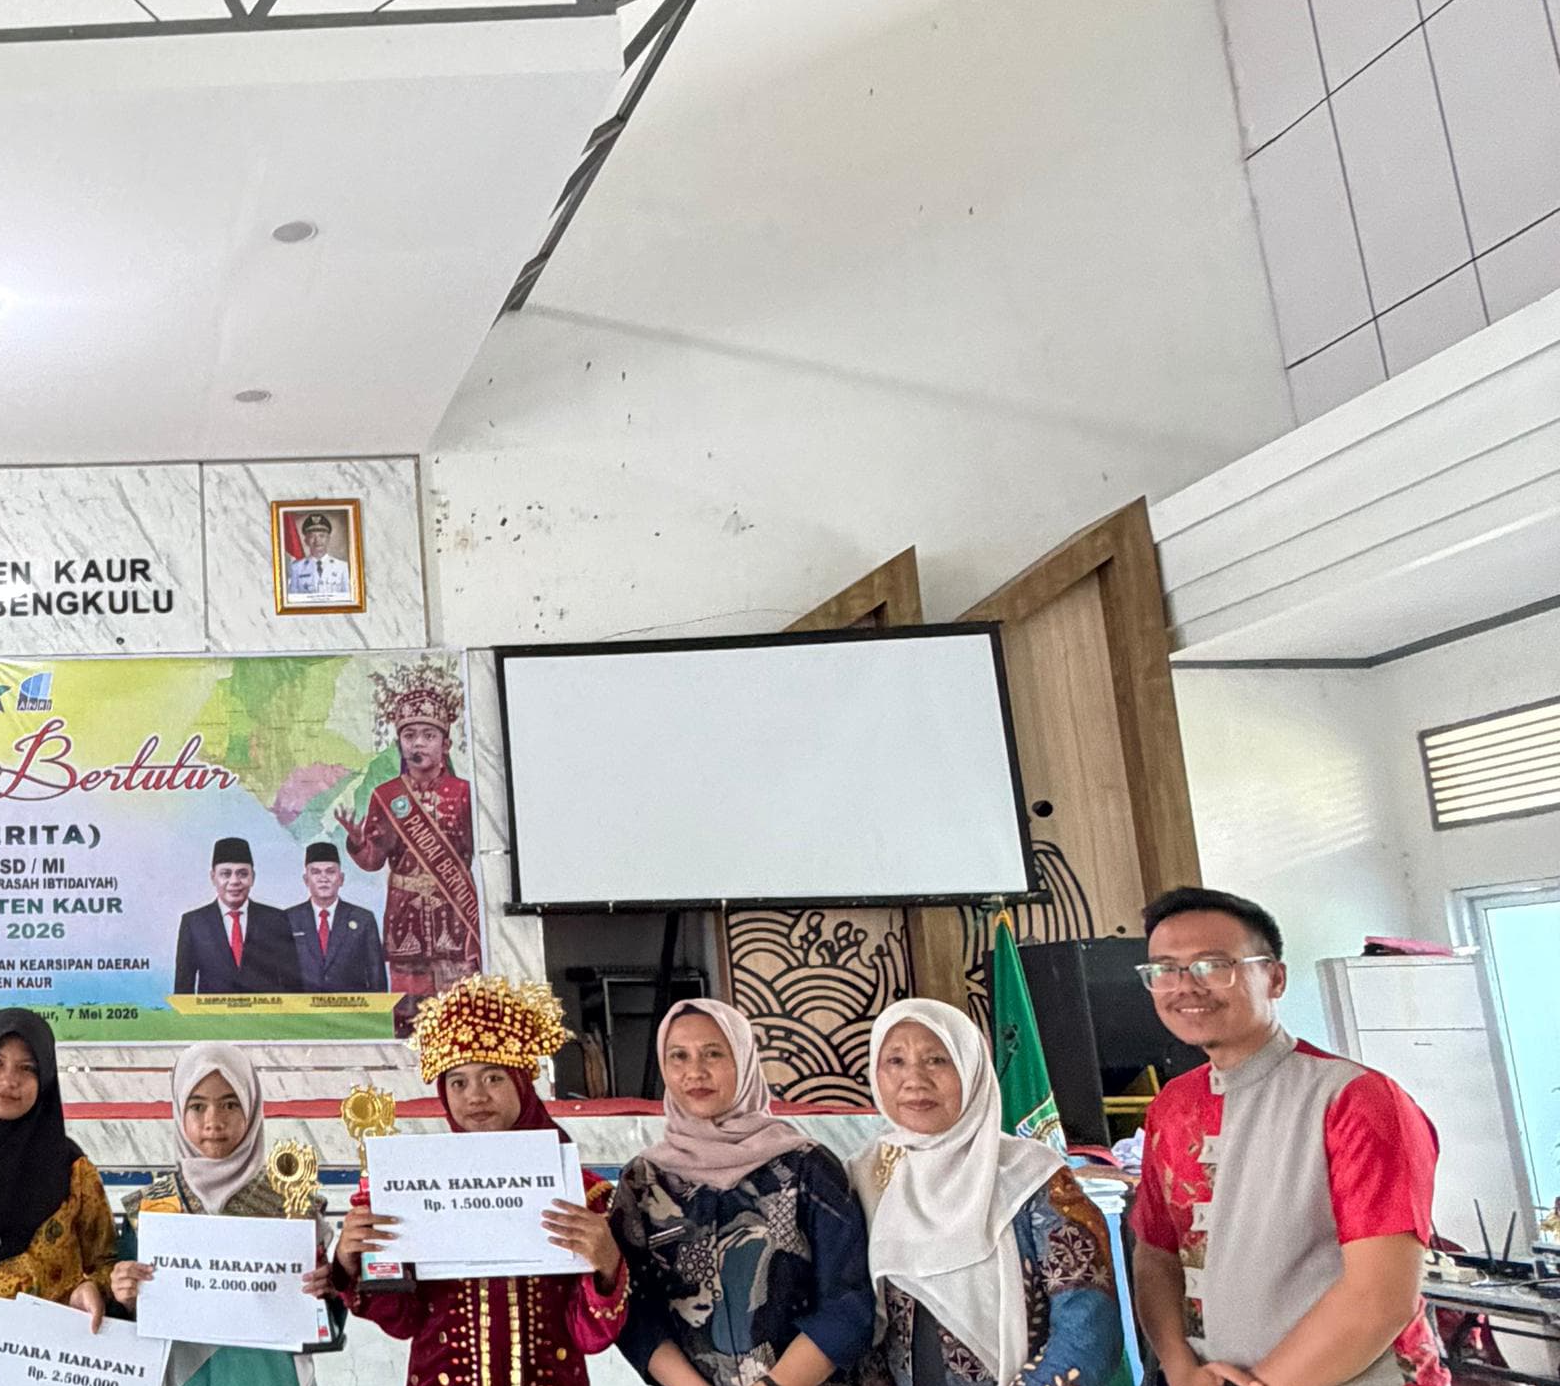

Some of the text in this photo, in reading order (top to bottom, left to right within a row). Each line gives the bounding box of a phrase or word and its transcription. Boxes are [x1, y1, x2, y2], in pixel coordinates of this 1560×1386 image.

[54, 558, 153, 584] KAUR
[403, 814, 443, 862] PANDAI
[0, 858, 26, 875] SD
[42, 858, 65, 874] MI
[43, 876, 118, 891] IBTIDAIYAH)
[53, 897, 123, 914] KAUR
[6, 922, 65, 939] 2026
[20, 958, 91, 971] KEARSIPAN
[97, 957, 150, 970] DAERAH
[16, 976, 53, 989] KAUR
[66, 1009, 75, 1020] 7
[79, 1008, 102, 1020] Mei
[106, 1008, 139, 1020] 2026
[383, 1175, 556, 1192] JUARA HARAPAN III
[423, 1196, 523, 1212] Rp. 1.500.000
[151, 1256, 303, 1274] JUARA HARAPAN II
[185, 1277, 277, 1292] Rp. 2.000.000
[27, 1365, 48, 1381] Rp.
[58, 1351, 136, 1376] HARAPAN
[138, 1366, 146, 1378] I
